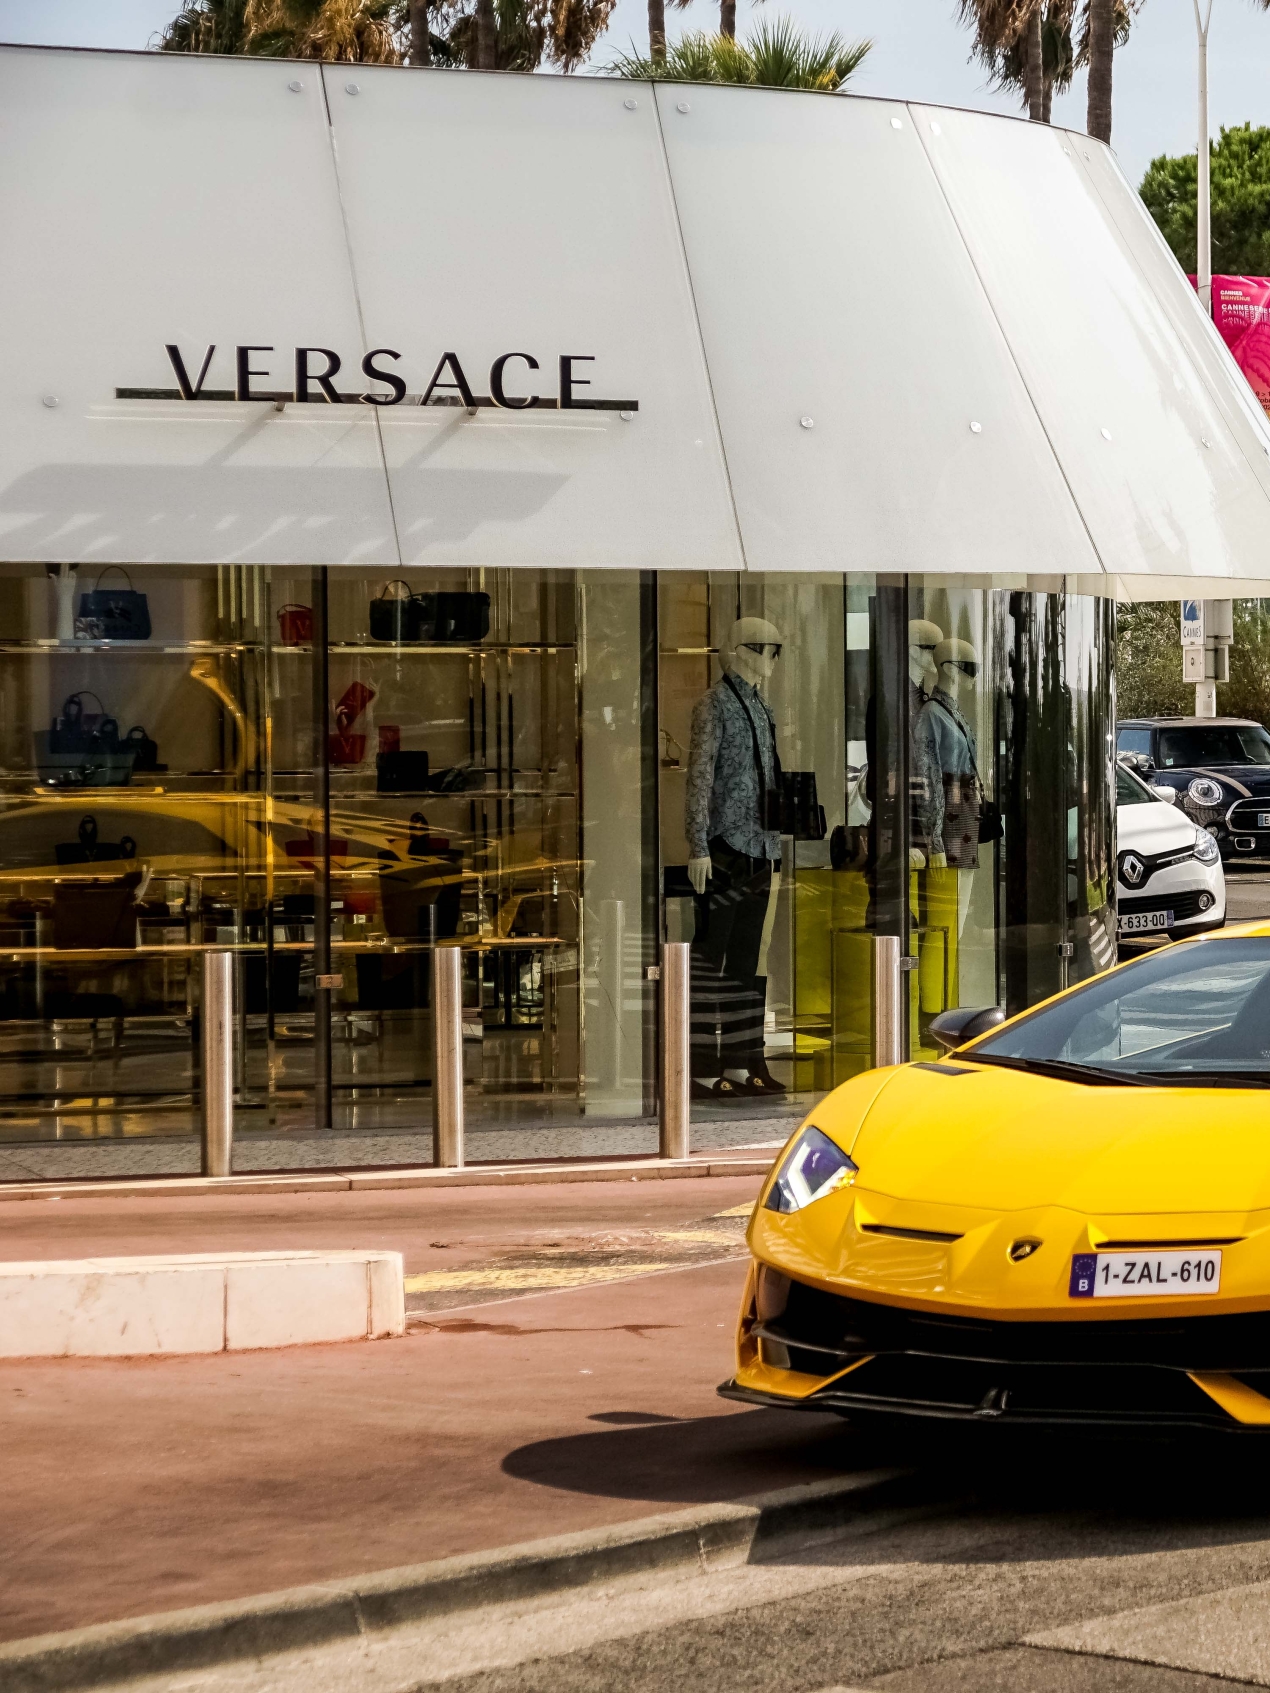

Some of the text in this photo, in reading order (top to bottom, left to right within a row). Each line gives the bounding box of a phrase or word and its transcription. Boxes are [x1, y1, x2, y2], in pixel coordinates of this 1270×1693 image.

[164, 344, 596, 410] VERSACE
[1182, 625, 1202, 638] CANNES
[1101, 1259, 1216, 1286] 1-ZAL-610
[1078, 1279, 1089, 1292] B
